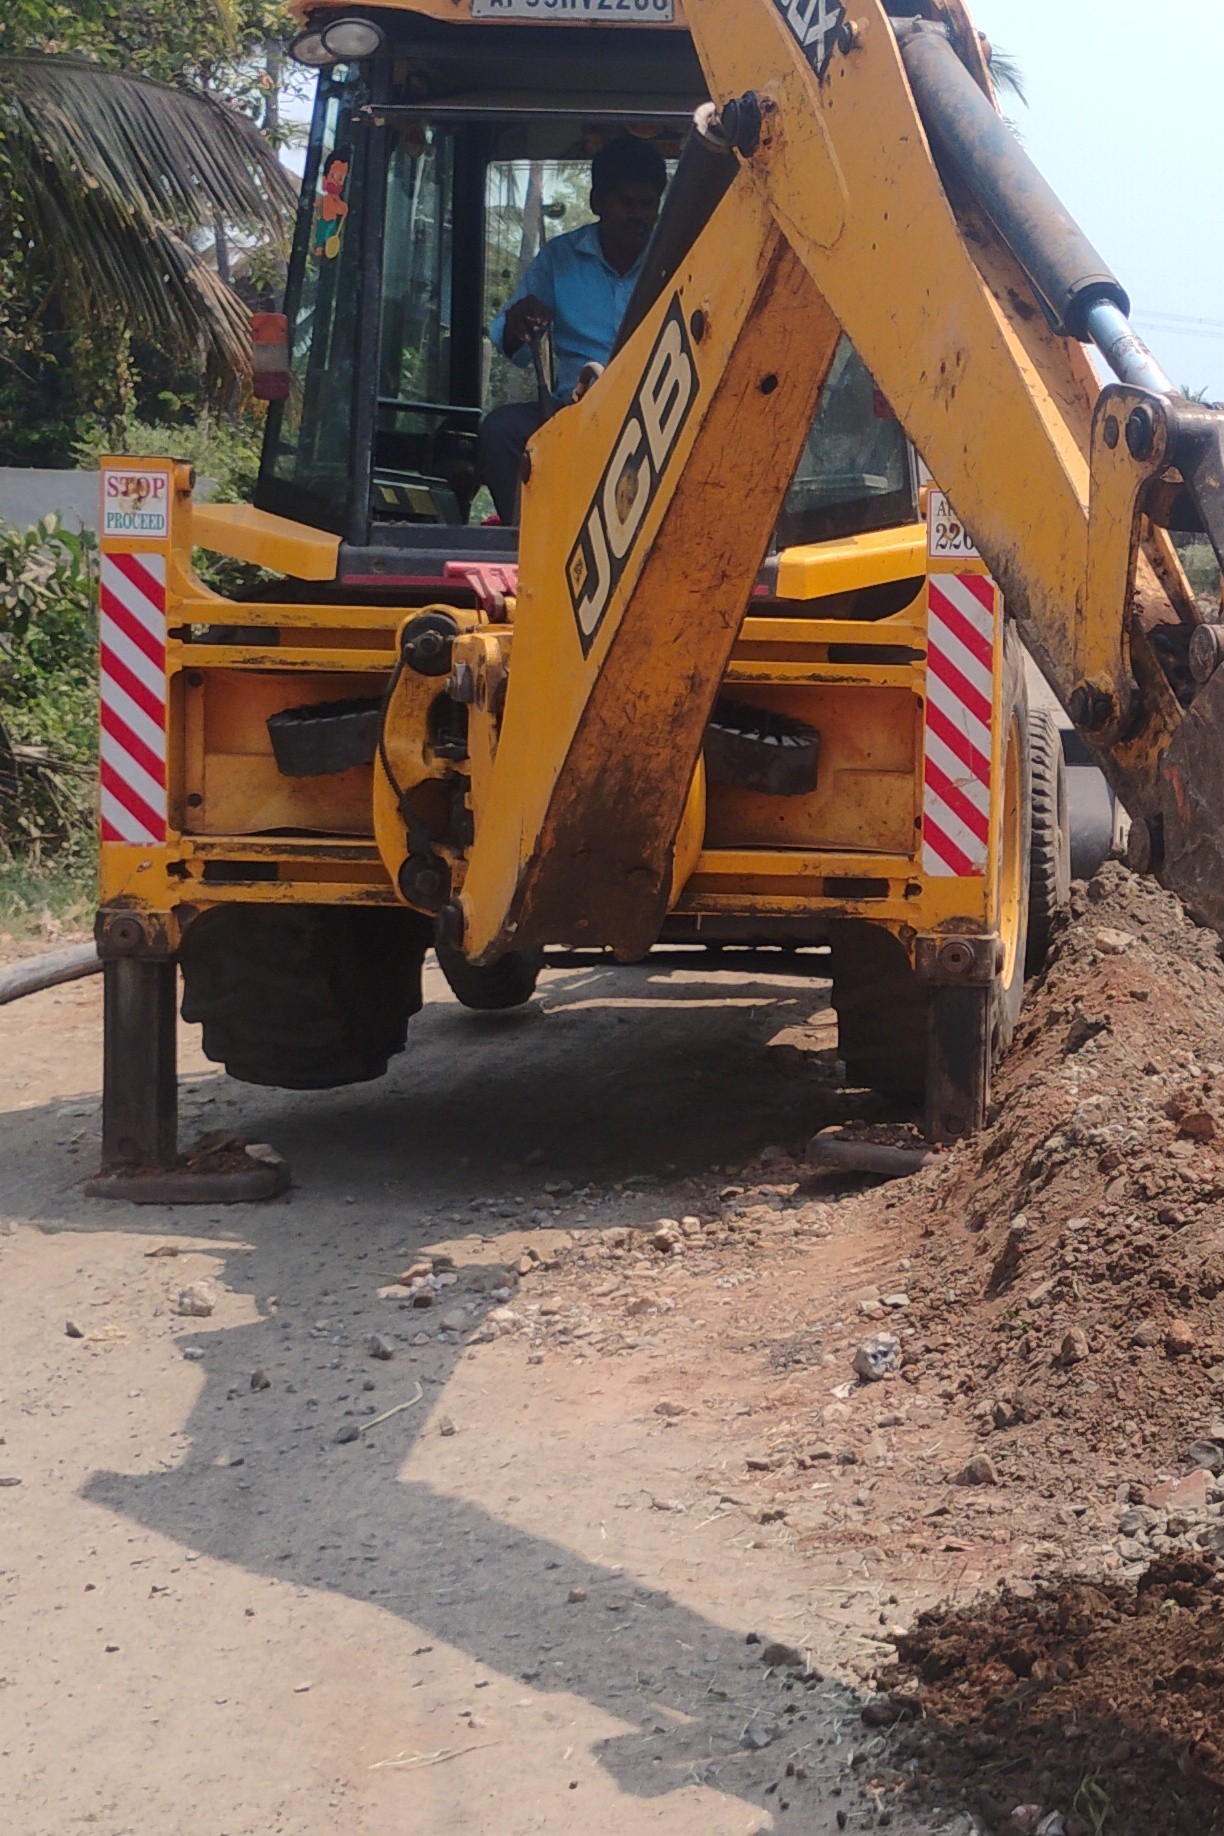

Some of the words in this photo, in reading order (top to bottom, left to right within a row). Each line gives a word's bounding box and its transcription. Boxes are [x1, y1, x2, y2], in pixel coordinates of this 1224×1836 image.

[106, 475, 165, 499] STOP
[578, 319, 692, 636] JCB
[106, 512, 165, 530] PROCEED
